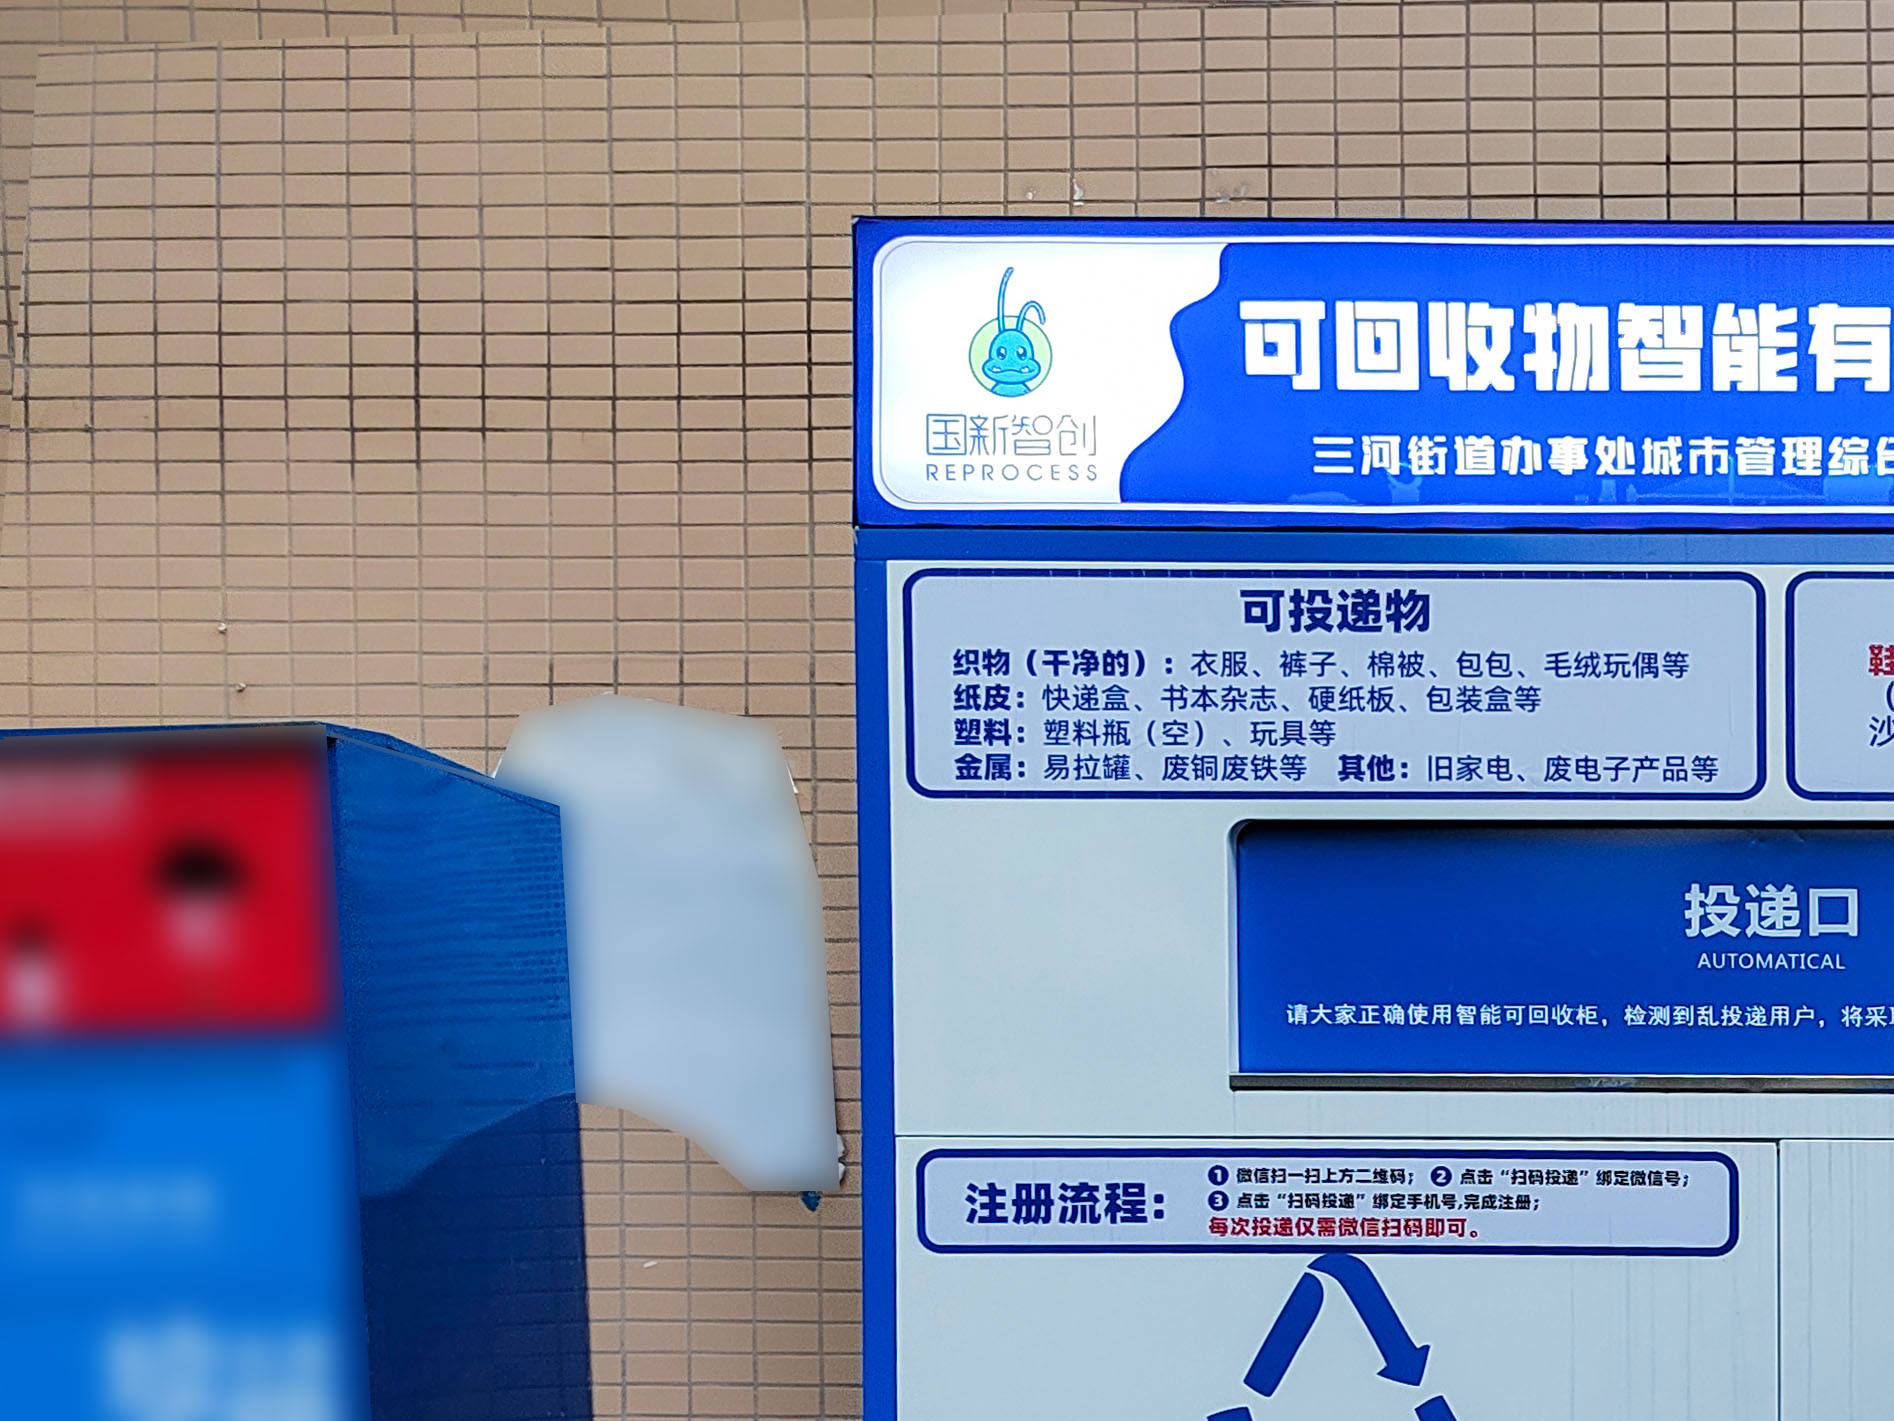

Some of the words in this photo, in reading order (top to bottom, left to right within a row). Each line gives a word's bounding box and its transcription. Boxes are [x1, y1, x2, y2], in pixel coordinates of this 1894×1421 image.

[925, 414, 1097, 457] 国新智创
[925, 463, 1098, 482] REPROCESS
[1240, 588, 1430, 633] 可投递物
[1684, 883, 1859, 938] 投递口
[1697, 953, 1846, 971] AUTOMATICAL
[965, 1182, 1165, 1225] 注册流程：
